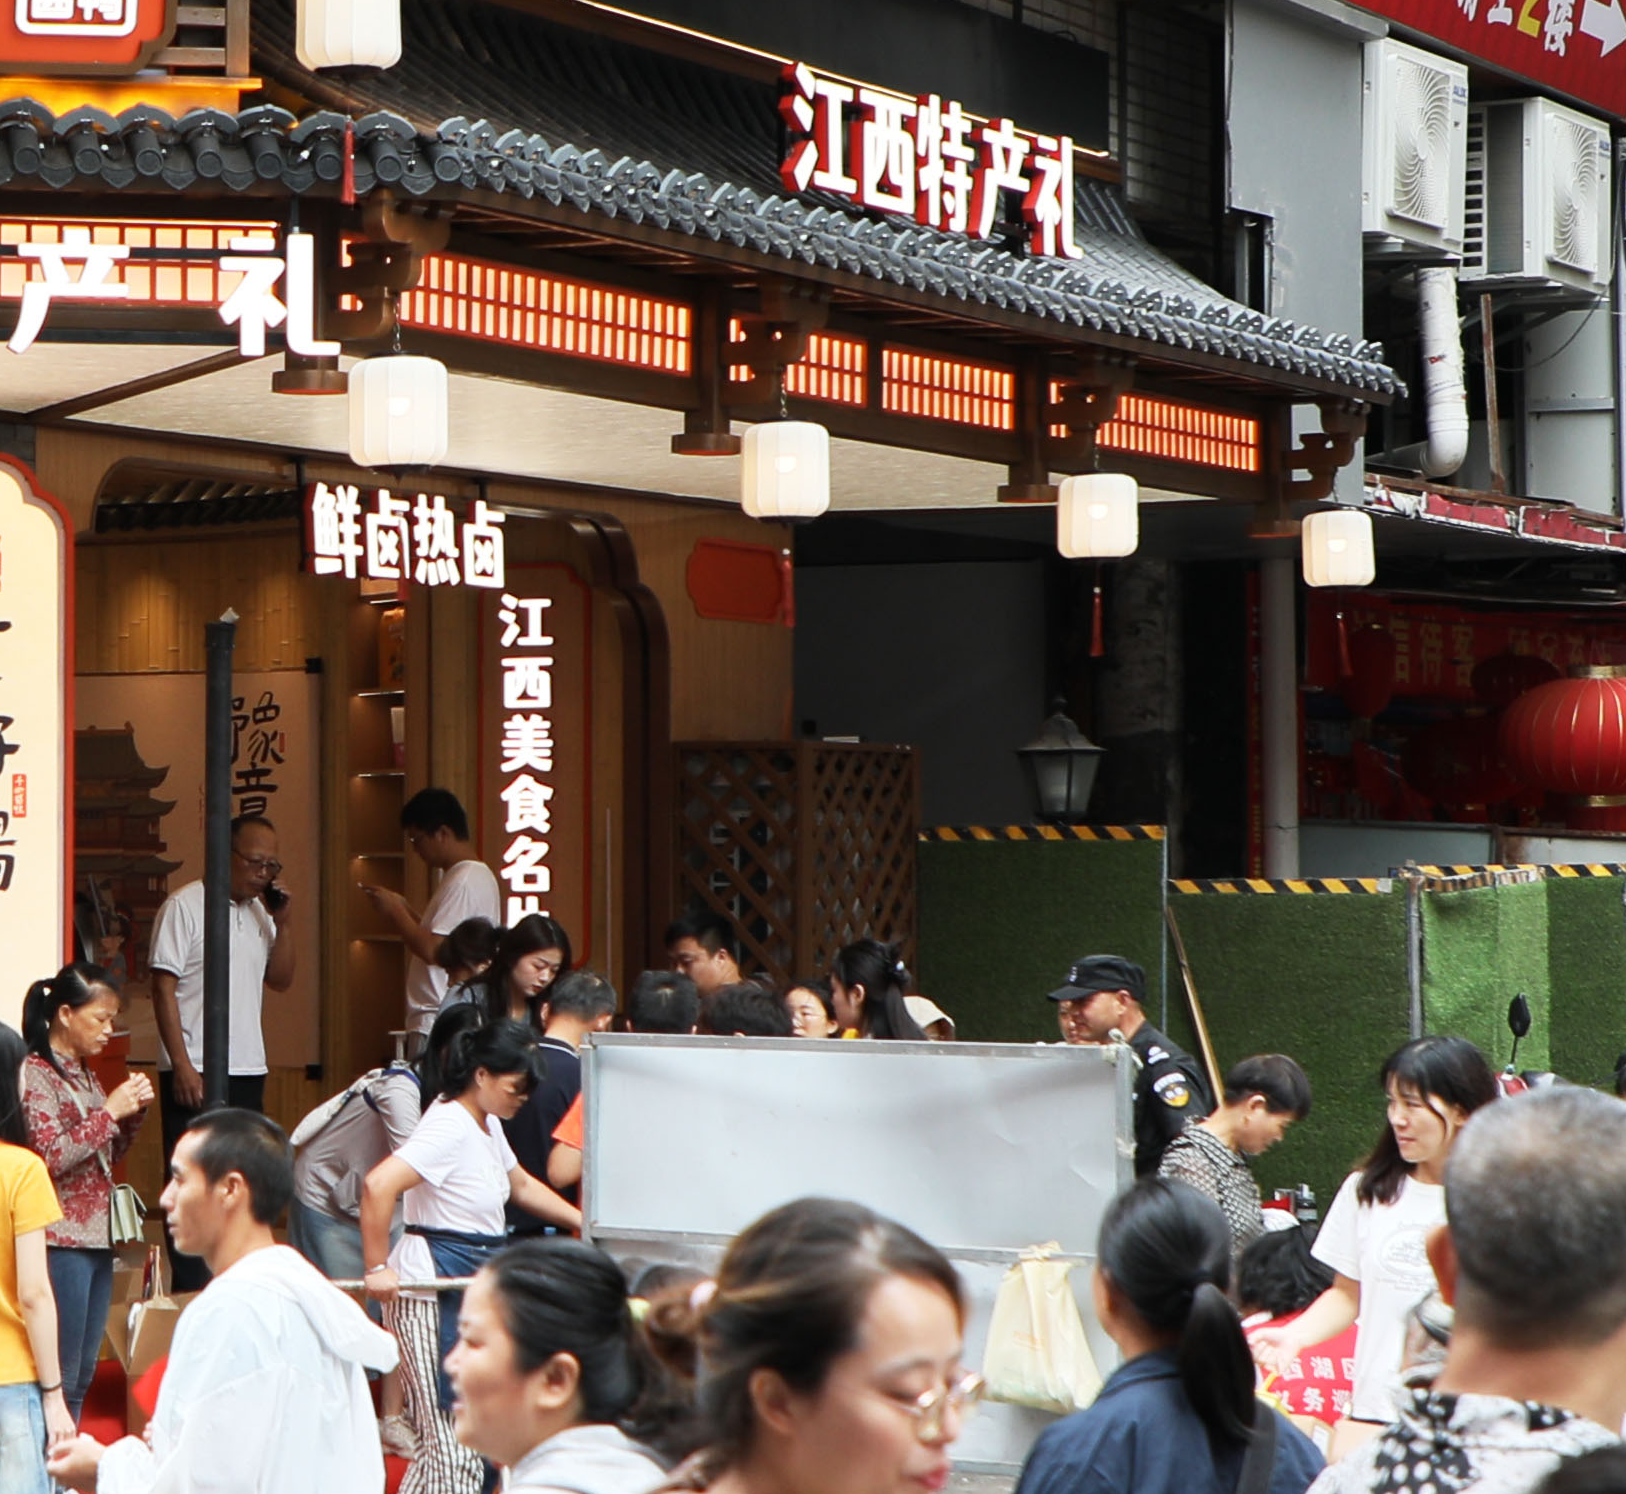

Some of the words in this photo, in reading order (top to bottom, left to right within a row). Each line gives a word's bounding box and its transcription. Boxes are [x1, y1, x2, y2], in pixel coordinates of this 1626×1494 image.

[790, 61, 1084, 261] 江西特产礼
[312, 481, 506, 589] 鲜卤热卤
